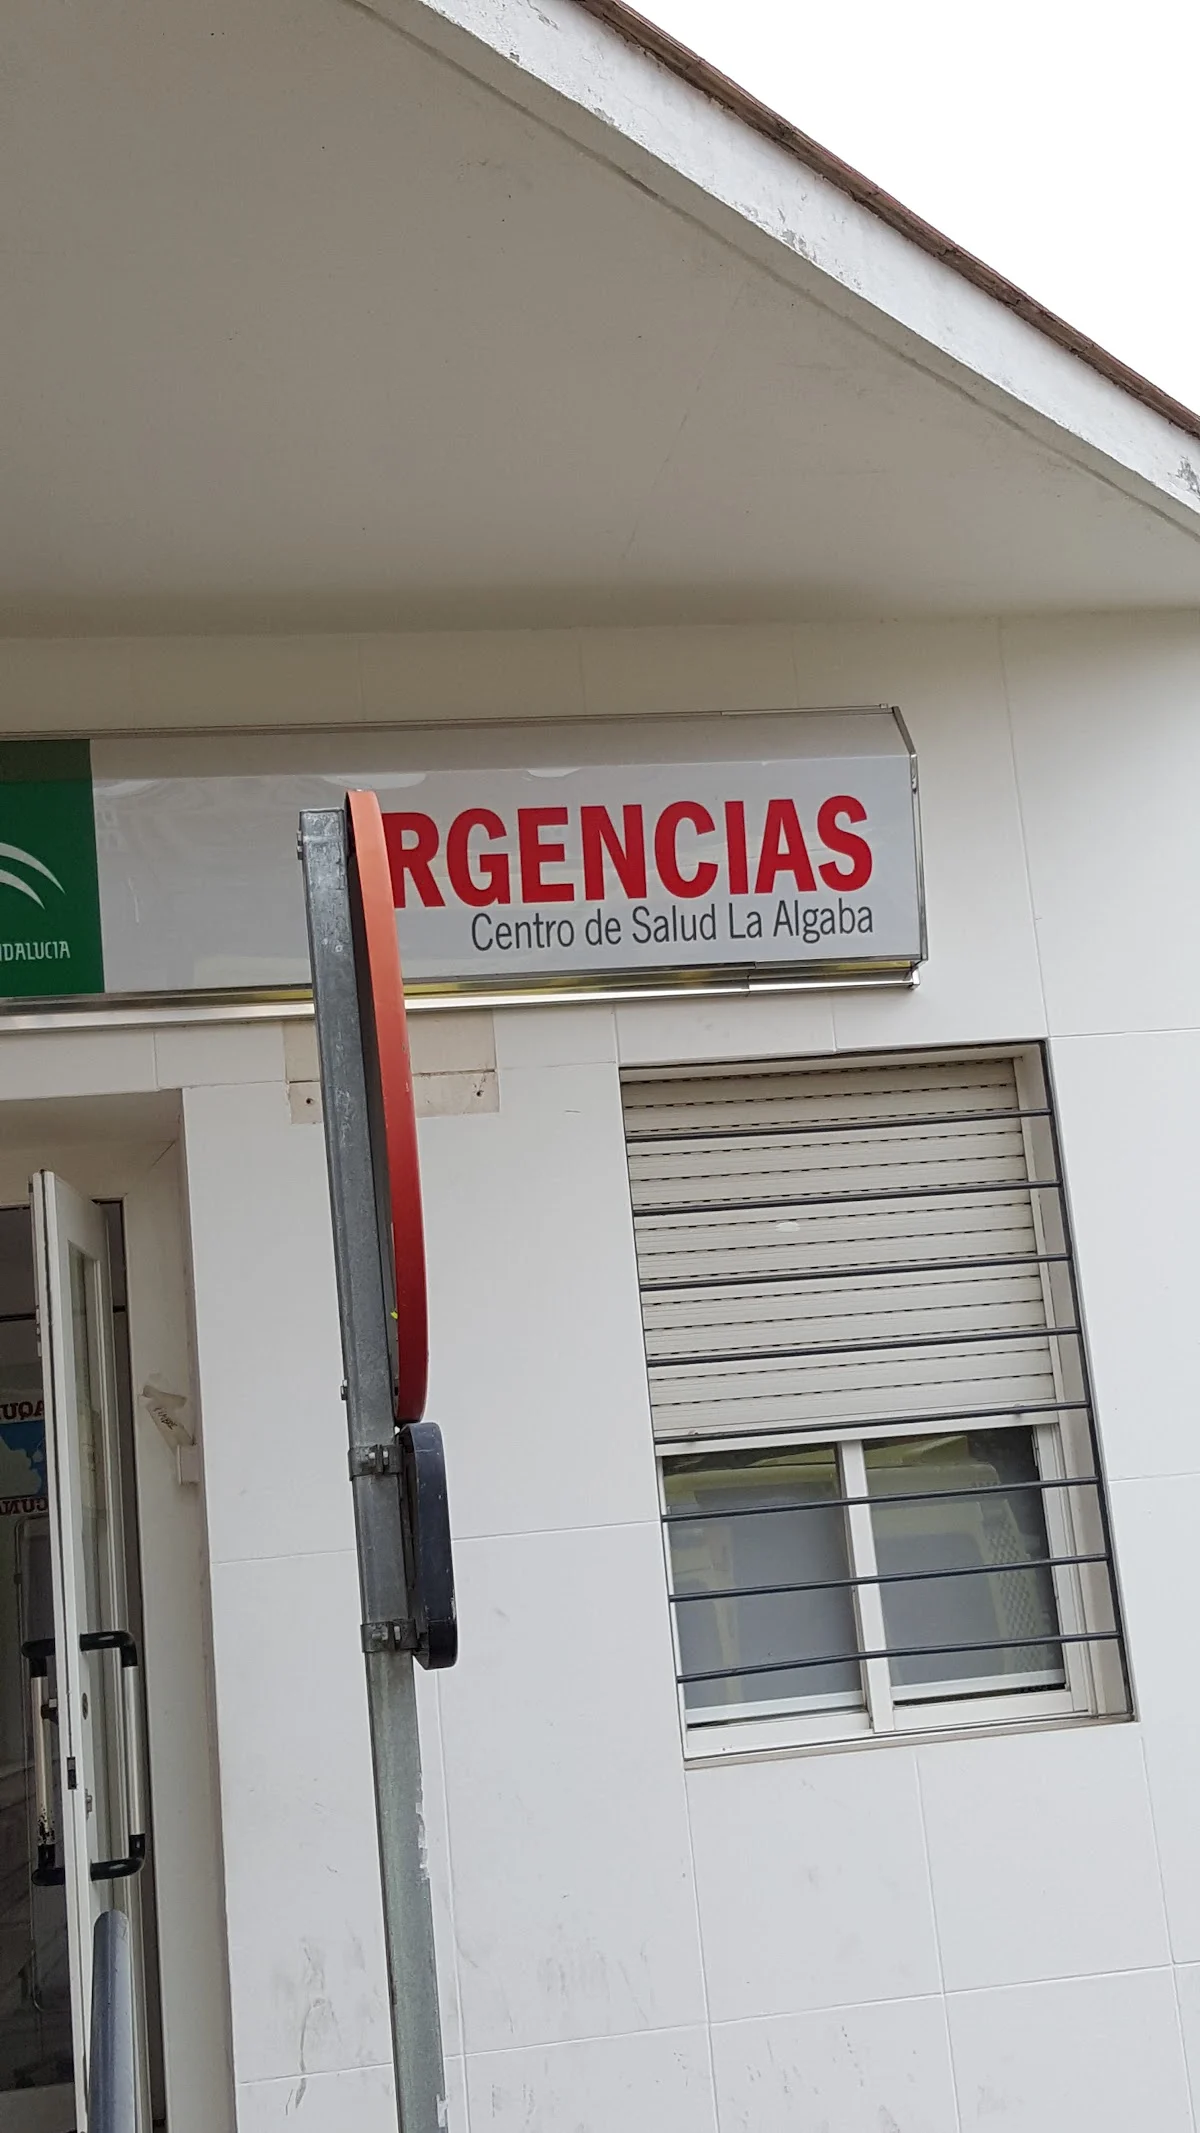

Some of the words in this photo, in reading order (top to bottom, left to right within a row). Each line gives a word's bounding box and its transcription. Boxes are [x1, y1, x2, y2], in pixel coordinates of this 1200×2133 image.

[381, 795, 873, 908] RGENCIAS
[0, 941, 71, 961] DALUCIA
[471, 911, 575, 951] Centro
[585, 909, 622, 946] de
[631, 903, 717, 944] Salud
[729, 903, 763, 940] La
[773, 897, 874, 943] Algaba
